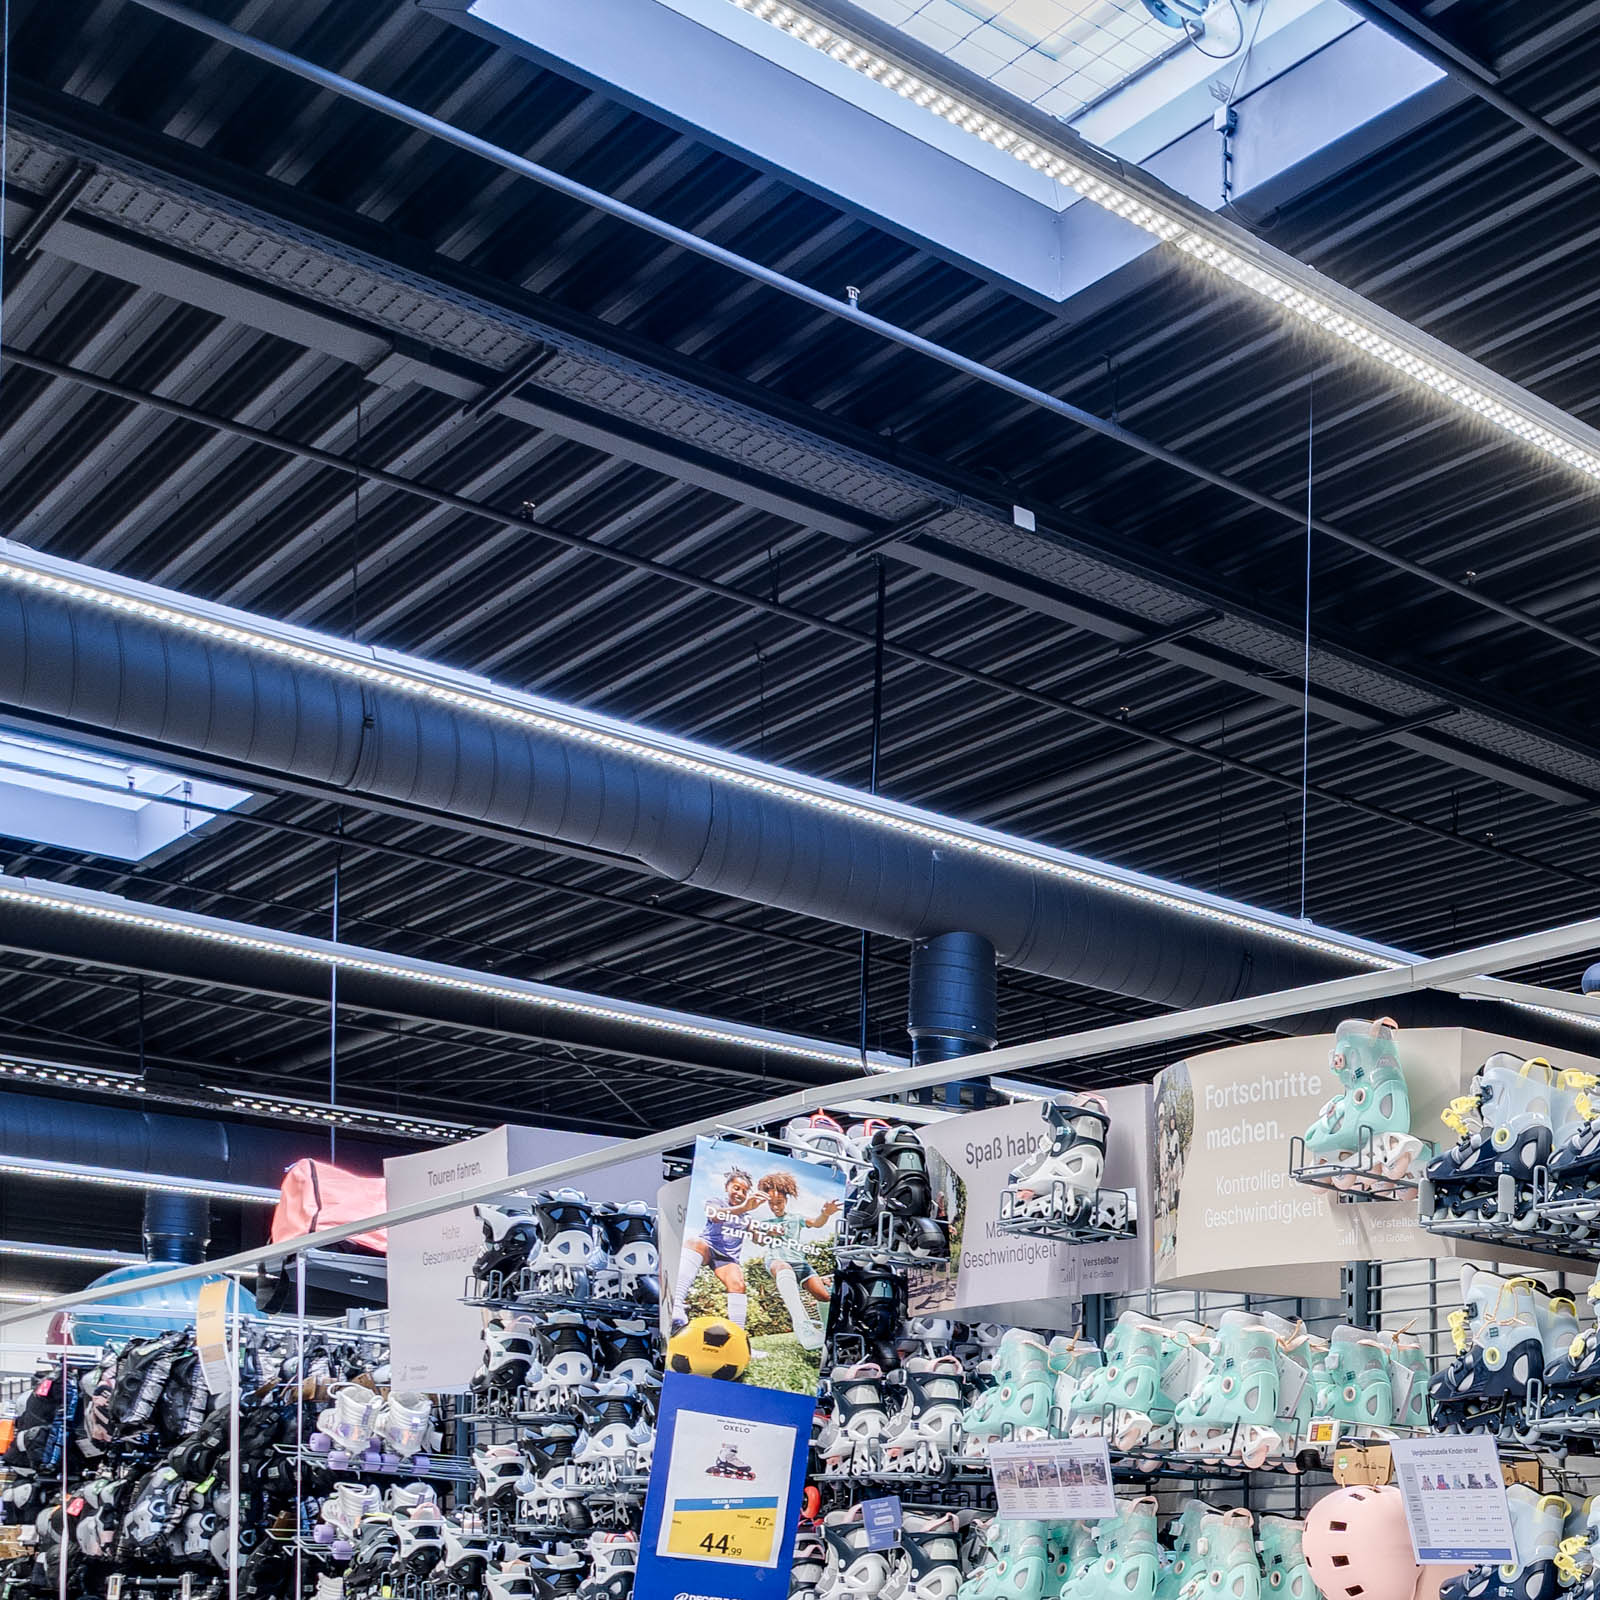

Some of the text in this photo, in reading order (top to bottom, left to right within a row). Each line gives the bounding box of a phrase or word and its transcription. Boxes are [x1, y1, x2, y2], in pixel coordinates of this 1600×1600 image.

[1204, 1071, 1322, 1111] Fortschritte
[1206, 1118, 1285, 1150] machen.
[965, 1136, 1003, 1169] Spaß
[427, 1168, 456, 1187] Touren
[704, 1206, 741, 1225] Dein
[742, 1214, 783, 1235] Sport
[1204, 1196, 1324, 1229] Geschwindigkeit
[721, 1225, 821, 1256] zum Top-Preis
[963, 1241, 1057, 1269] Geschwindigkeit
[723, 1424, 751, 1434] OXELO
